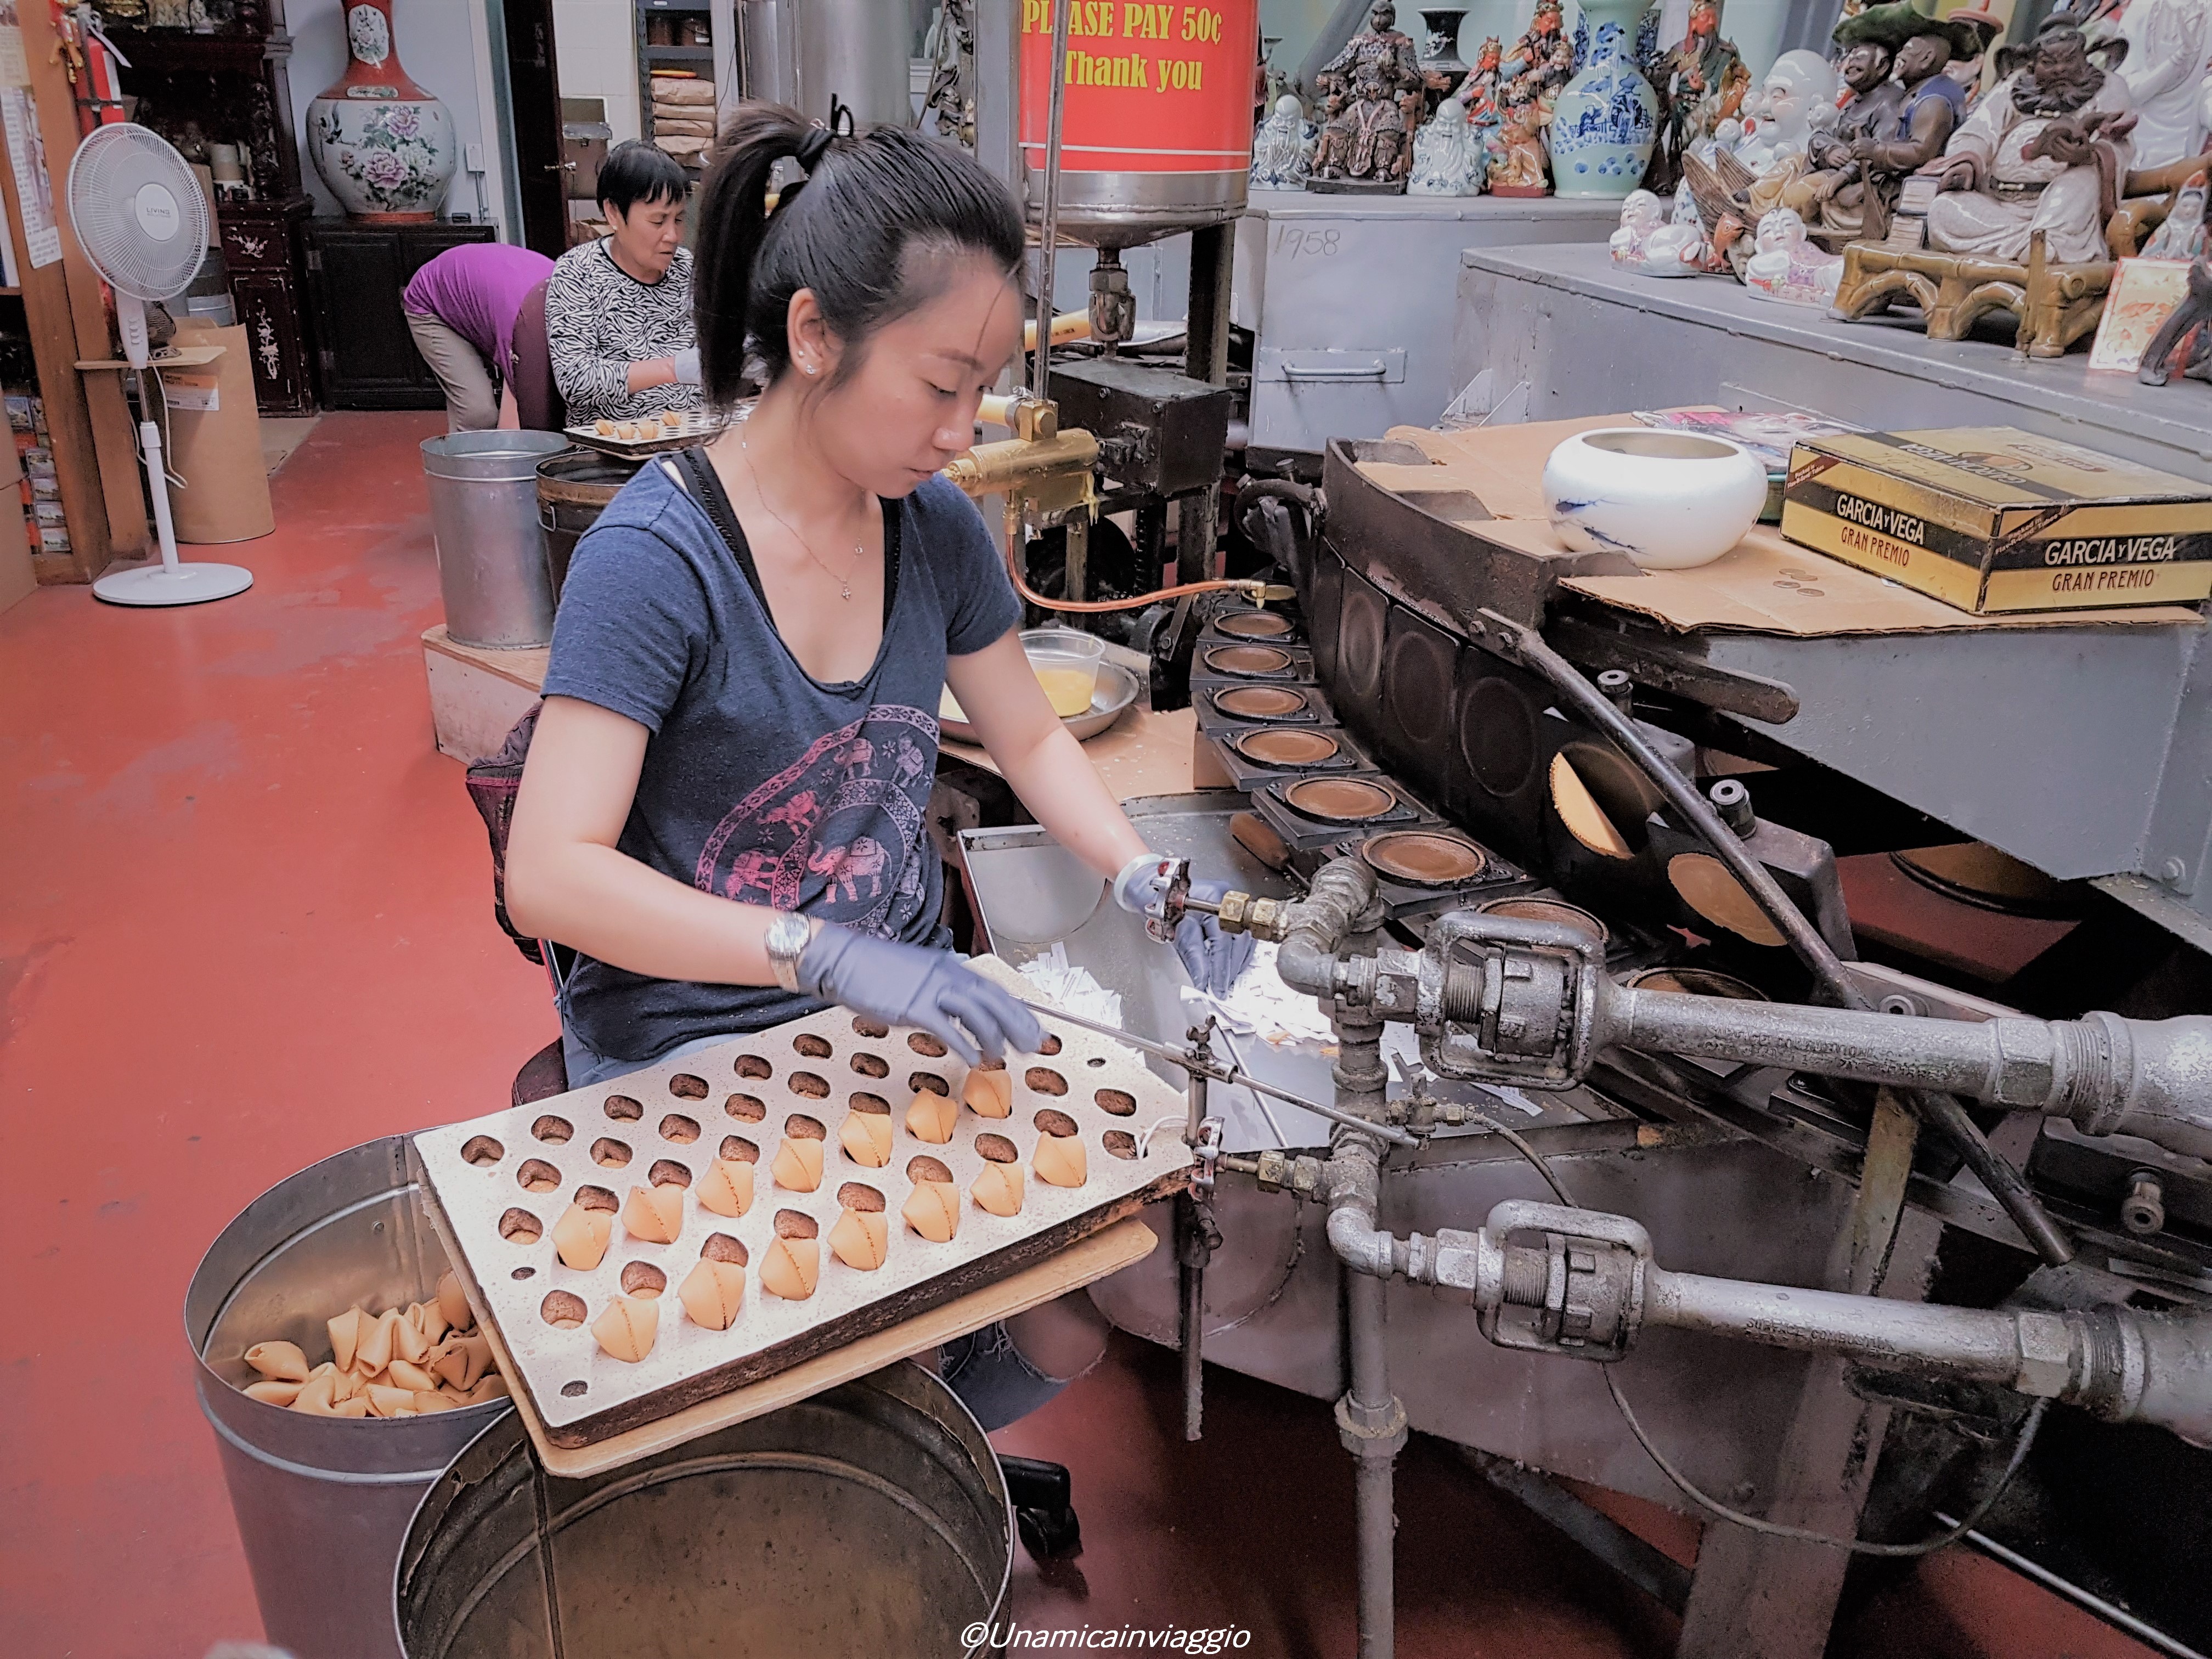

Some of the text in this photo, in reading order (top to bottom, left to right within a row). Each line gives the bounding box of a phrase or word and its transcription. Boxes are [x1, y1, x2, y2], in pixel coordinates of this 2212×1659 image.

[1022, 0, 1222, 45] PLASE PAY 50¢
[1064, 50, 1203, 93] Thank you
[1273, 225, 1340, 262] 1958
[1837, 494, 1883, 530] GARCIA
[1891, 511, 1925, 545] VEGA
[1841, 526, 1910, 568] GRAN PREMIO
[2044, 538, 2117, 566] GARCIA
[2128, 537, 2175, 562] VEGA
[2052, 569, 2154, 593] GRAN PREMIO
